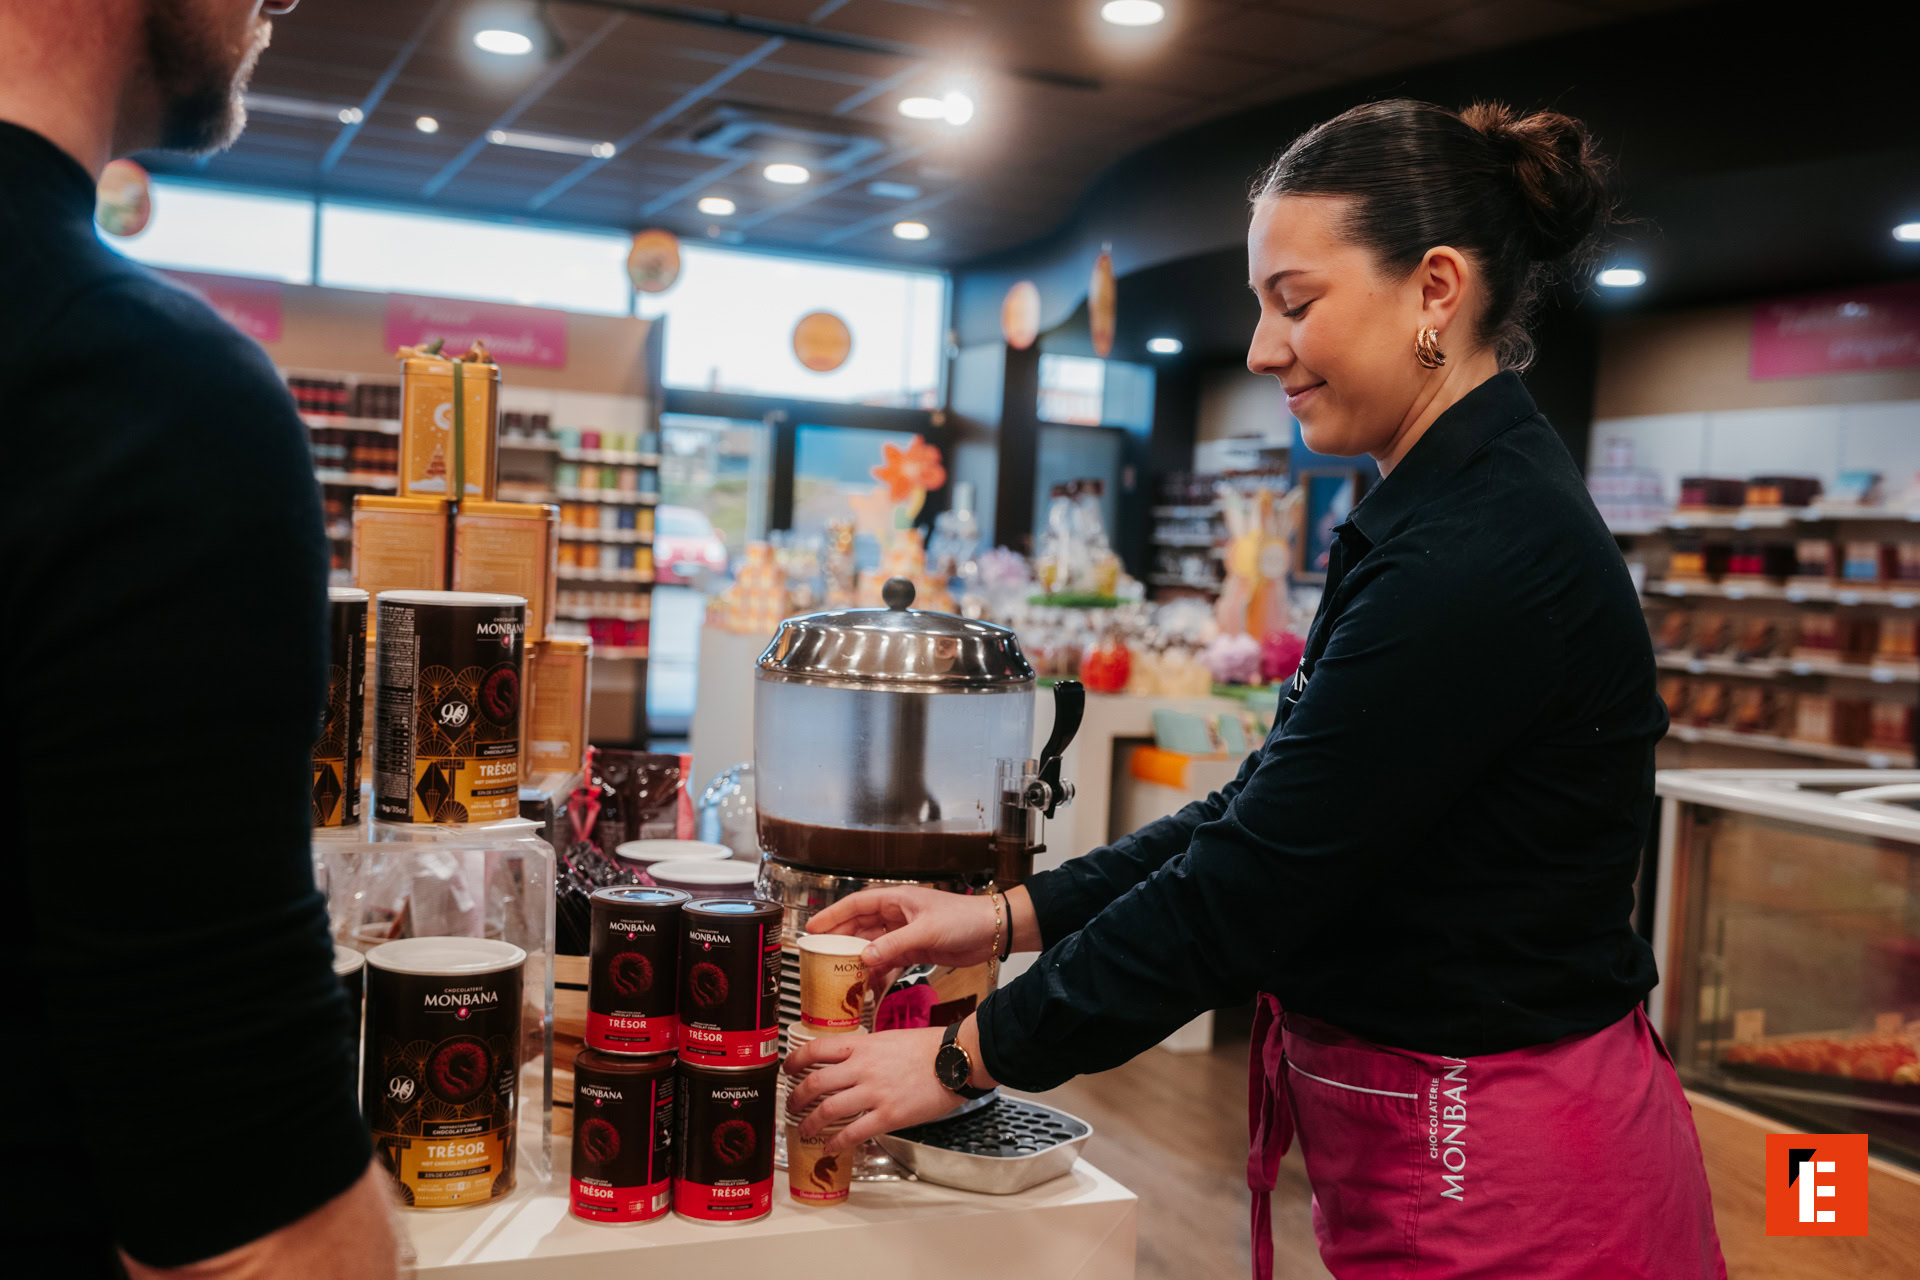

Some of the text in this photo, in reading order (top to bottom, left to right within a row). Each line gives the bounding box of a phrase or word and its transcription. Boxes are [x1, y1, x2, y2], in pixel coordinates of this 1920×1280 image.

[476, 623, 524, 635] MONBAN
[479, 761, 517, 776] TRÉSOR
[609, 922, 656, 932] MONBANA
[689, 931, 731, 944] MONBANA
[834, 963, 865, 972] MONB
[424, 991, 498, 1006] MONBANA
[609, 1018, 647, 1029] TRÉSOR
[688, 1030, 723, 1043] TRÉSOR
[580, 1086, 623, 1100] MONBANA
[712, 1089, 759, 1099] MONBANA
[1428, 1077, 1440, 1159] CHOCOLATERIE
[464, 1125, 483, 1133] CHAUD
[428, 1142, 485, 1158] TRÉSOR
[579, 1184, 614, 1198] TRÉSOR
[712, 1186, 751, 1198] TRÉSOR
